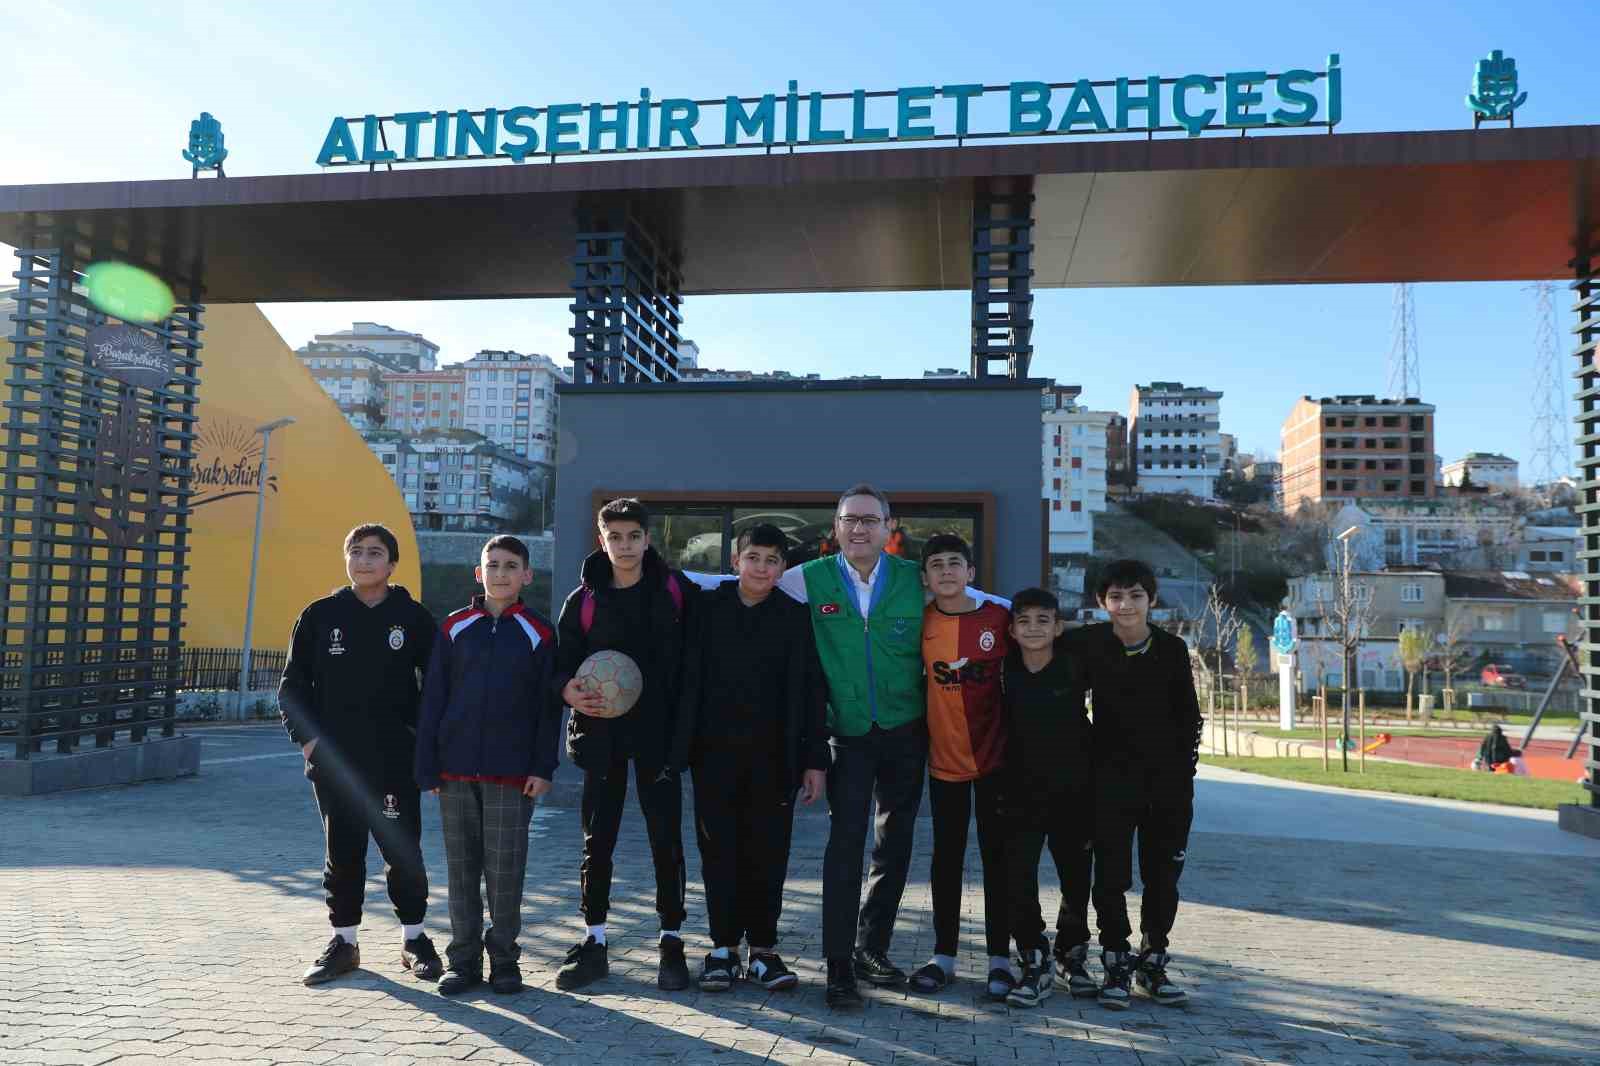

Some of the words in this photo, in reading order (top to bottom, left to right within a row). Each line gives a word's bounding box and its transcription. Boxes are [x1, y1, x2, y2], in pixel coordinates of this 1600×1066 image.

[316, 88, 701, 166] ALTINŞEHİR
[725, 79, 983, 147] MİLLET
[1008, 53, 1342, 137] BAHÇESİ
